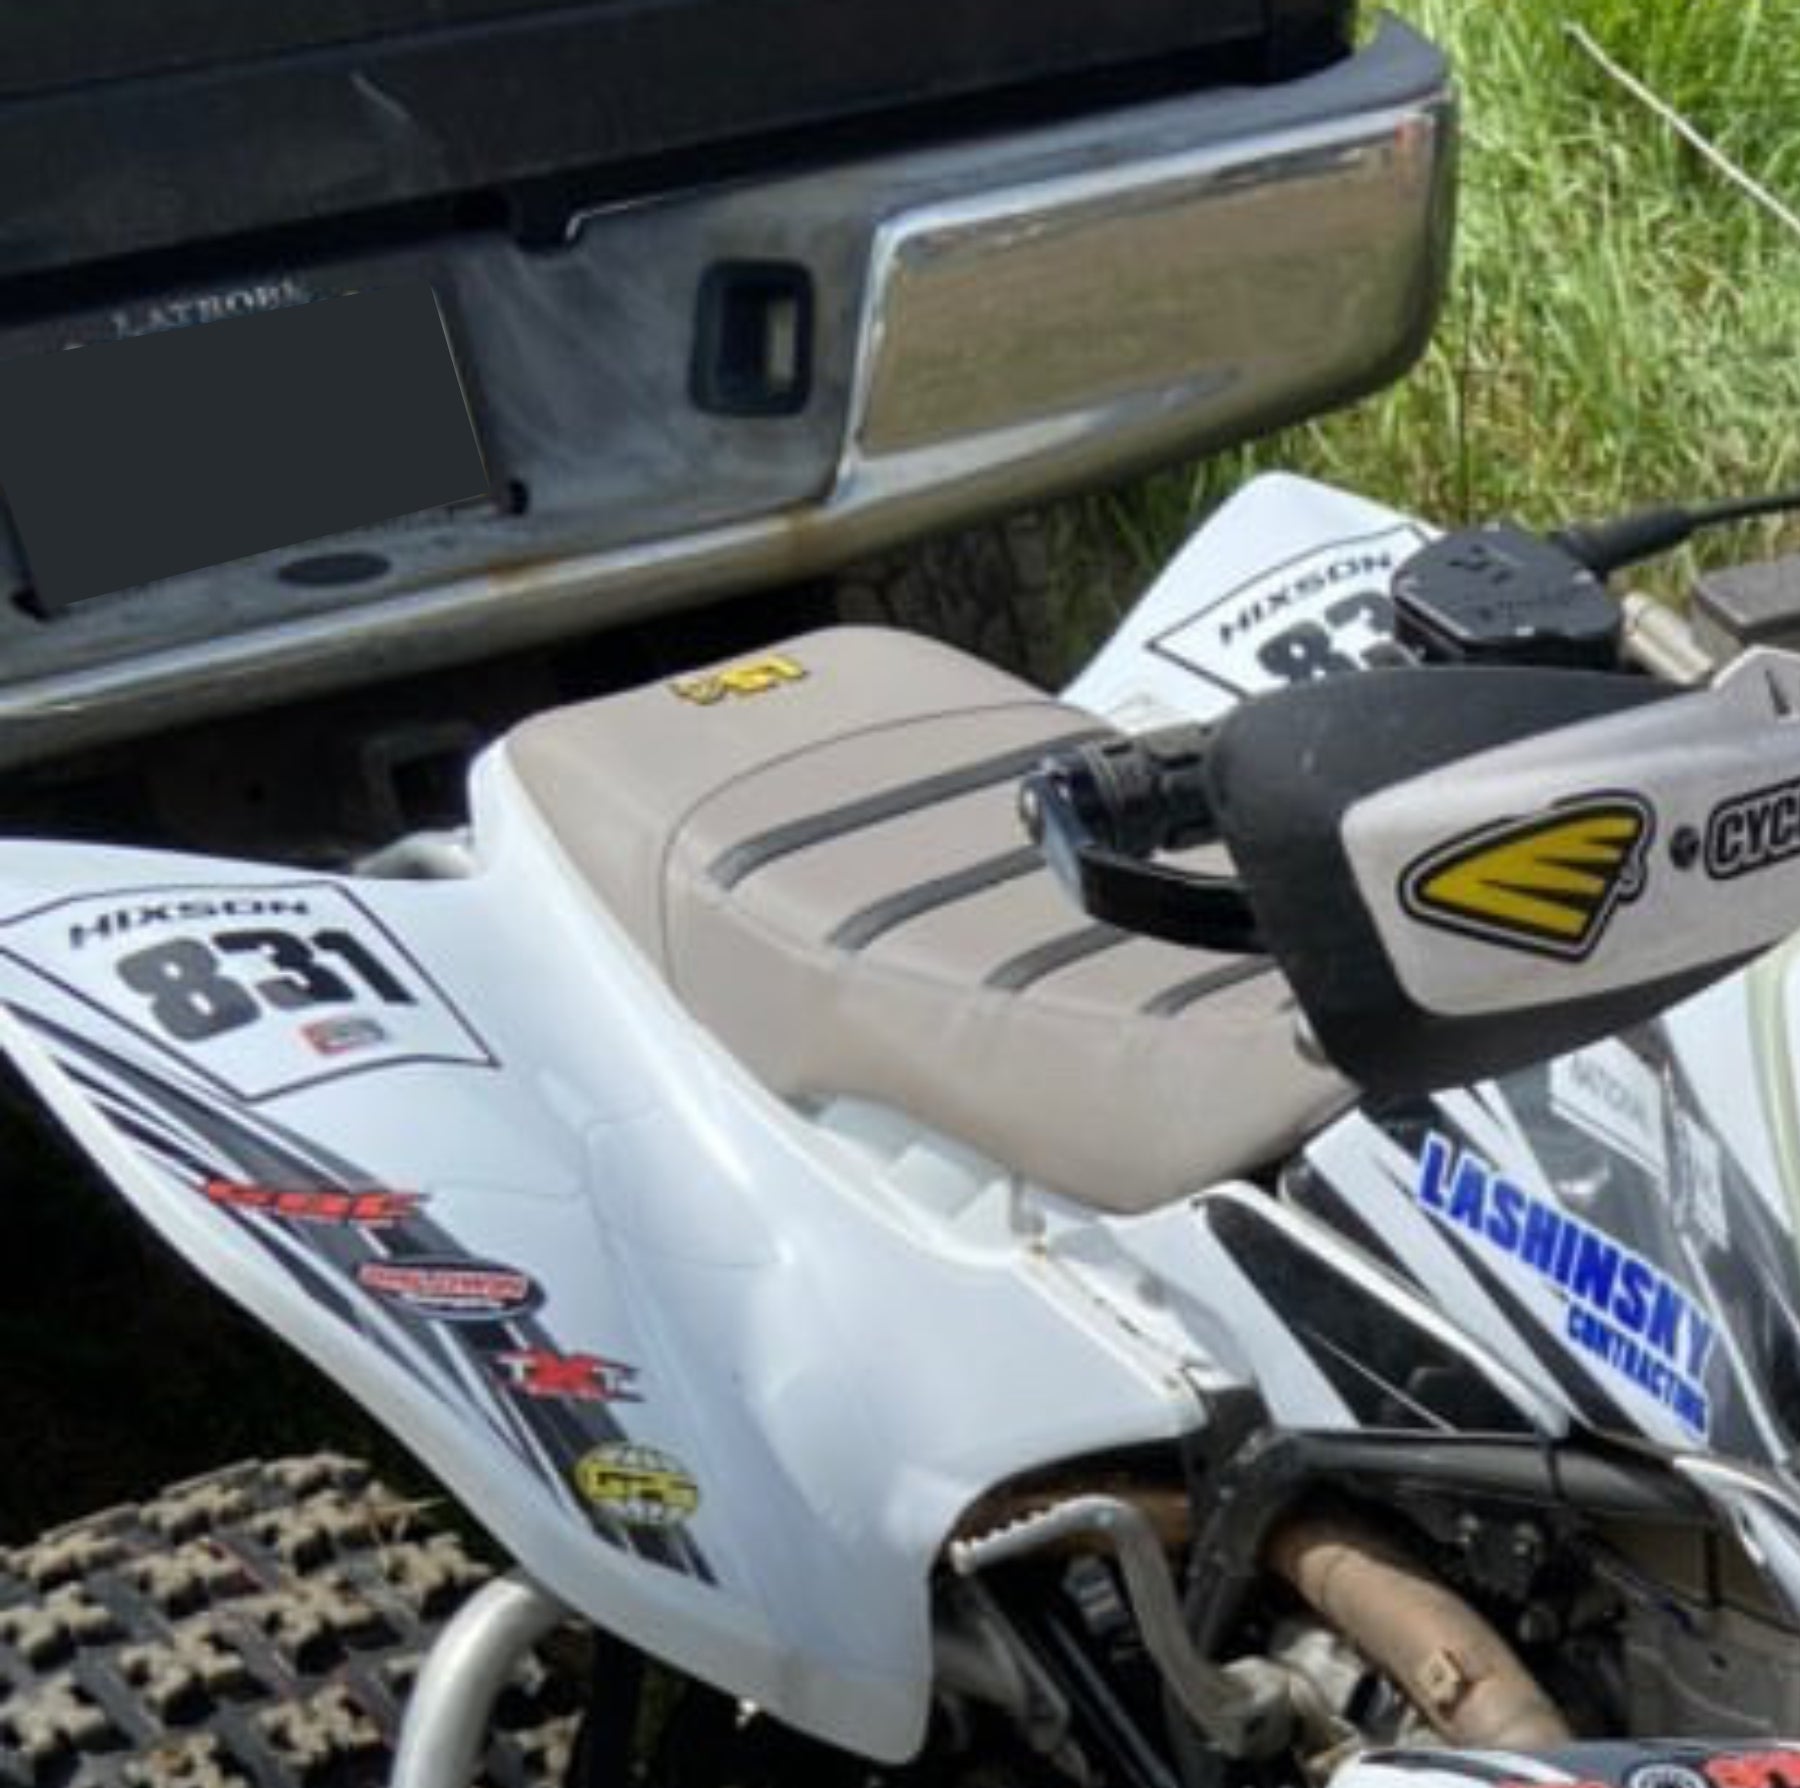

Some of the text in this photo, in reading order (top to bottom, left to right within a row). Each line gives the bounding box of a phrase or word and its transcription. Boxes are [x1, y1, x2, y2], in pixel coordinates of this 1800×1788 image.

[1220, 552, 1392, 646] HIXSON
[69, 899, 311, 949] HIXSON
[115, 927, 419, 1042] 831
[1418, 1134, 1716, 1380] LASHINSKY
[1566, 1303, 1708, 1435] CONTRACTING
